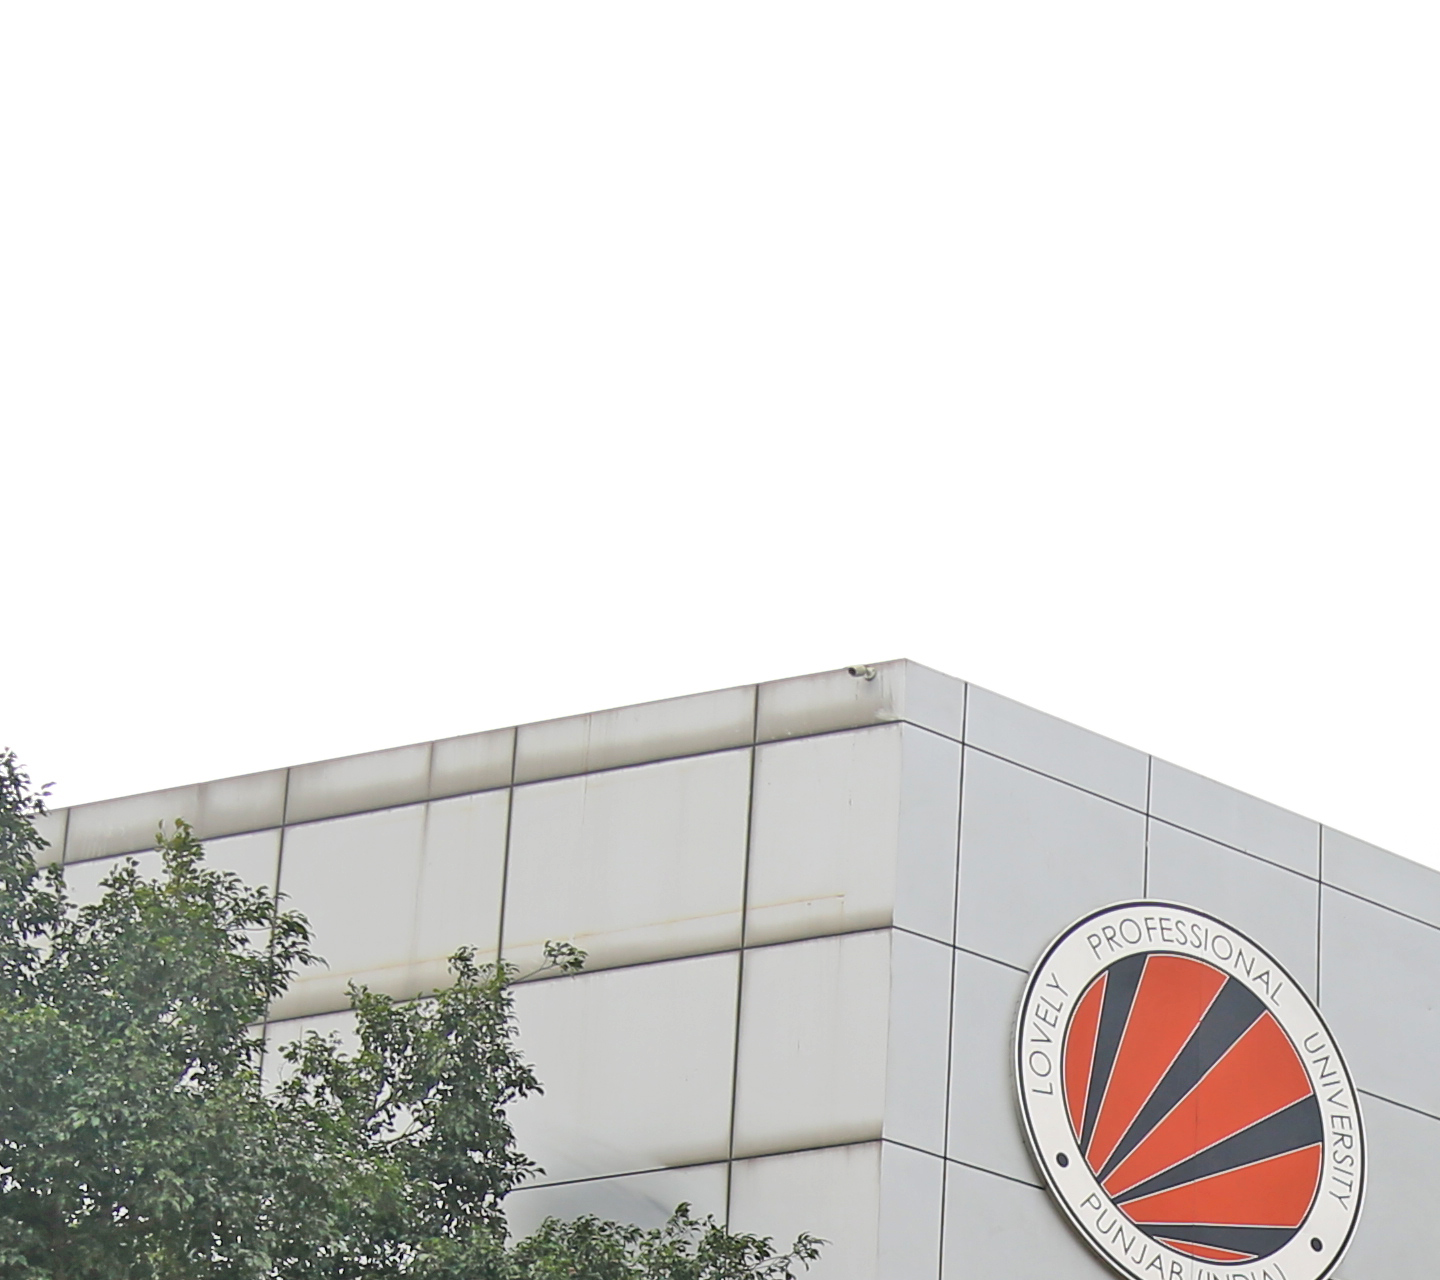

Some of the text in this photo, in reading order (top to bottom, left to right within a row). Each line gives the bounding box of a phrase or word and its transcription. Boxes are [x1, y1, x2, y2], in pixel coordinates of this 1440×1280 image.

[1029, 916, 1355, 1210] LOVELY PROFESSIONAL UNIVERSITY
